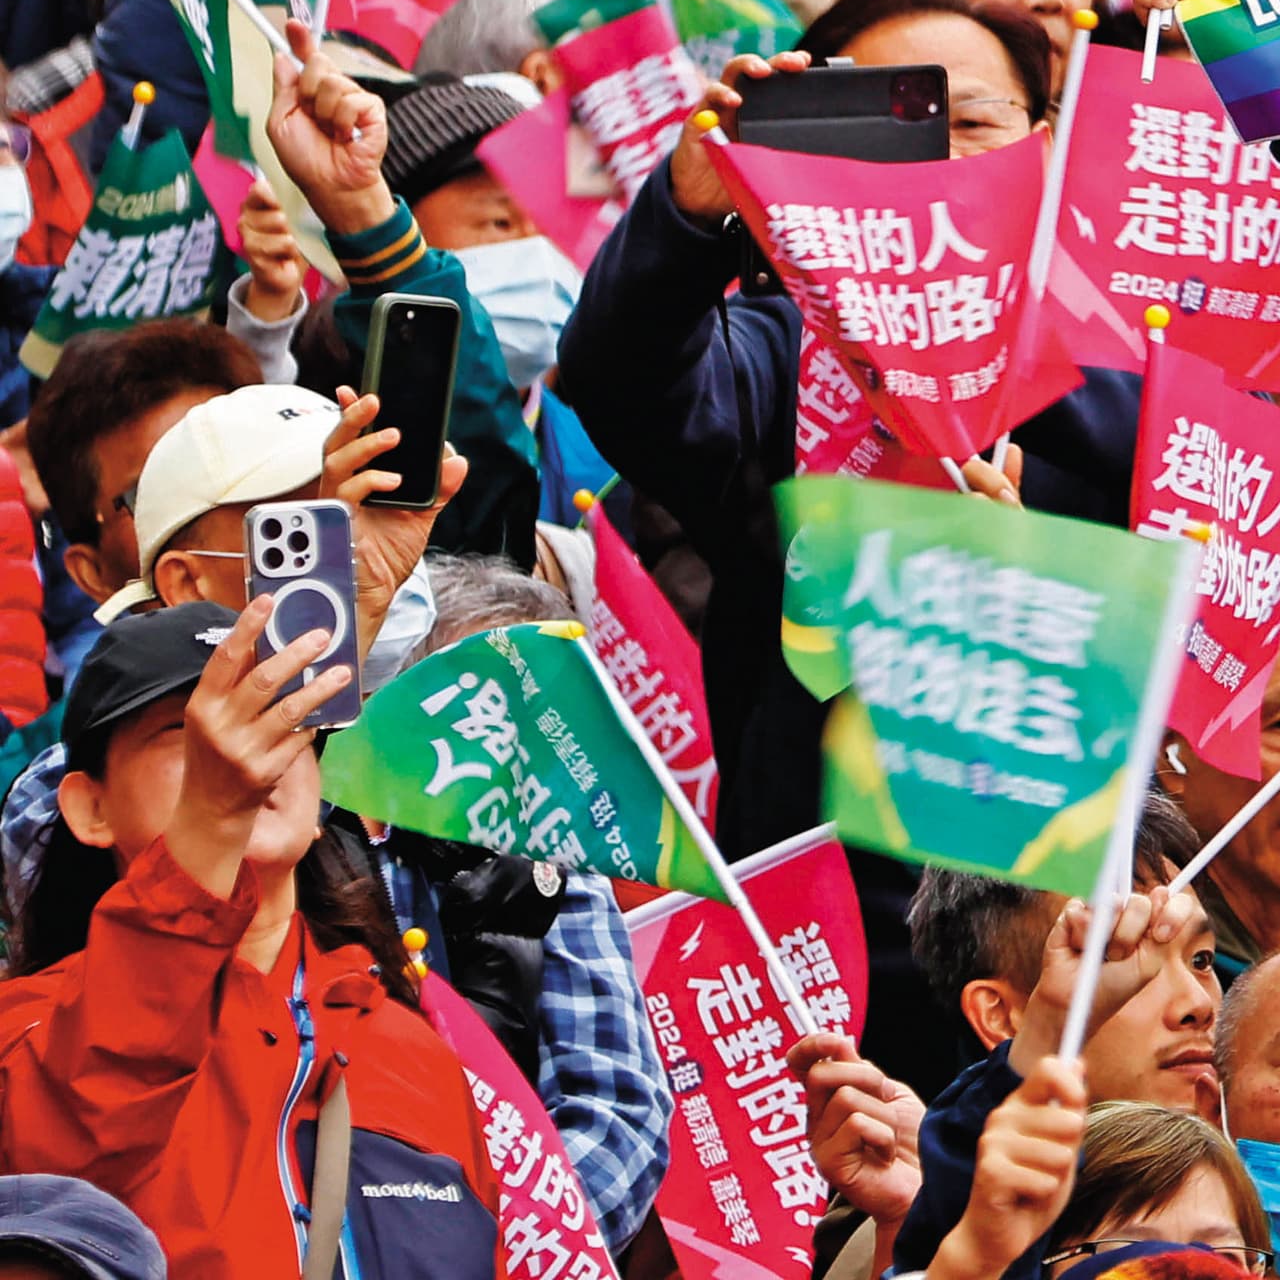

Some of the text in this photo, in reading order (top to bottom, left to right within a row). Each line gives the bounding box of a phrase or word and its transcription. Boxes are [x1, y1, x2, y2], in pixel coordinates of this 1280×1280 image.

[767, 201, 986, 276] 選對的人
[1109, 271, 1180, 303] 2024
[646, 991, 761, 1247] 2024 挺 賴清德 蕭美琴
